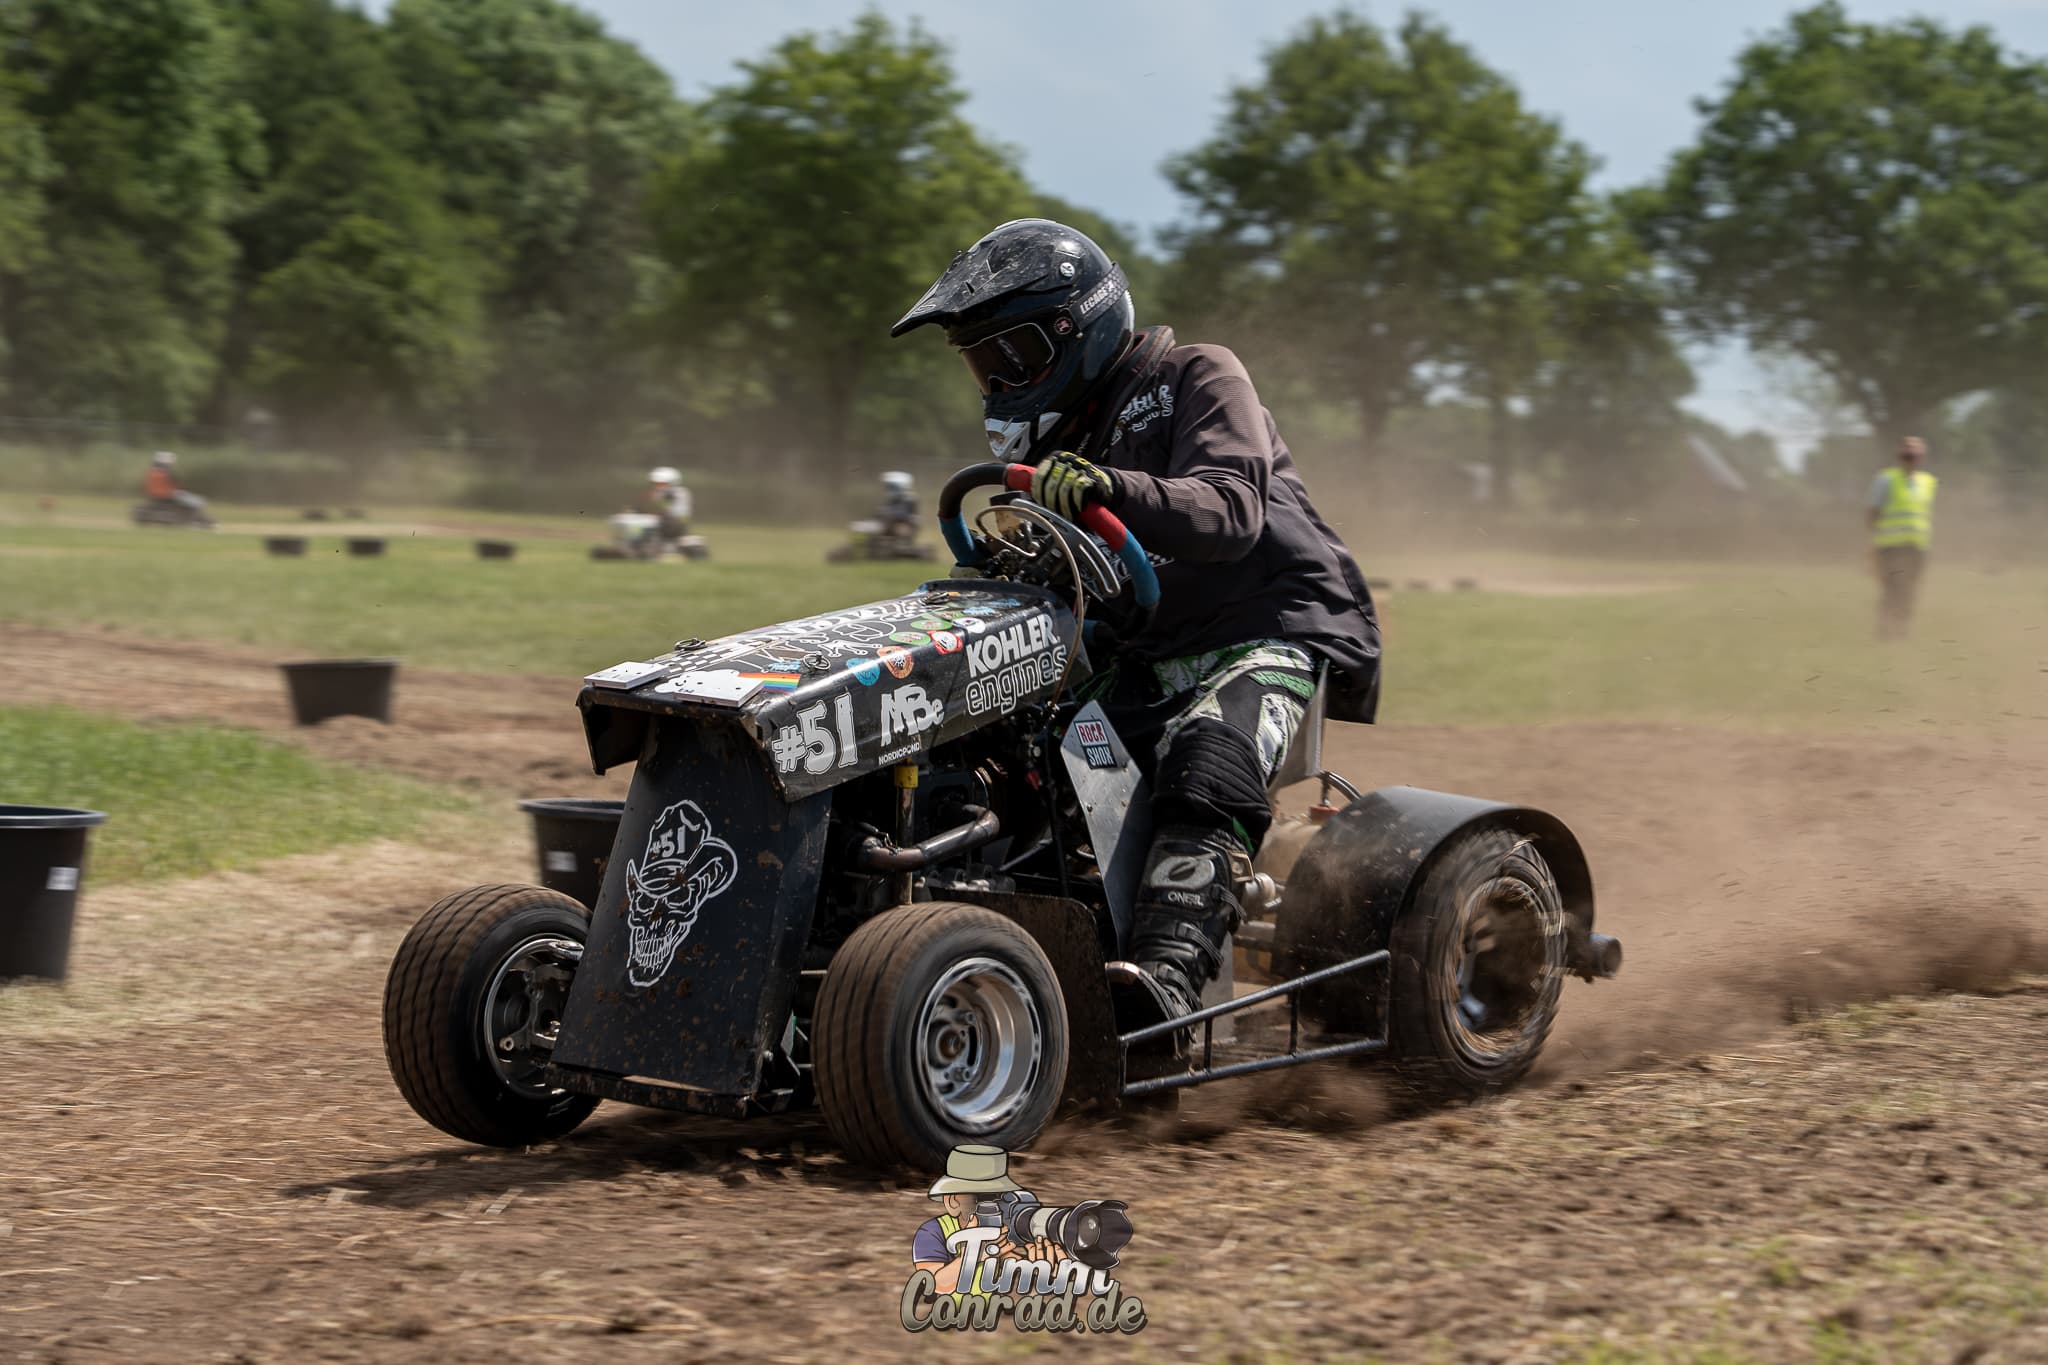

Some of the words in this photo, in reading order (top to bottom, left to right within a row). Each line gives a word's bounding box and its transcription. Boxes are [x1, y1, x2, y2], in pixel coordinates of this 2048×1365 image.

[965, 613, 1058, 679] KOHLER
[965, 644, 1068, 716] engines
[771, 691, 858, 775] #51
